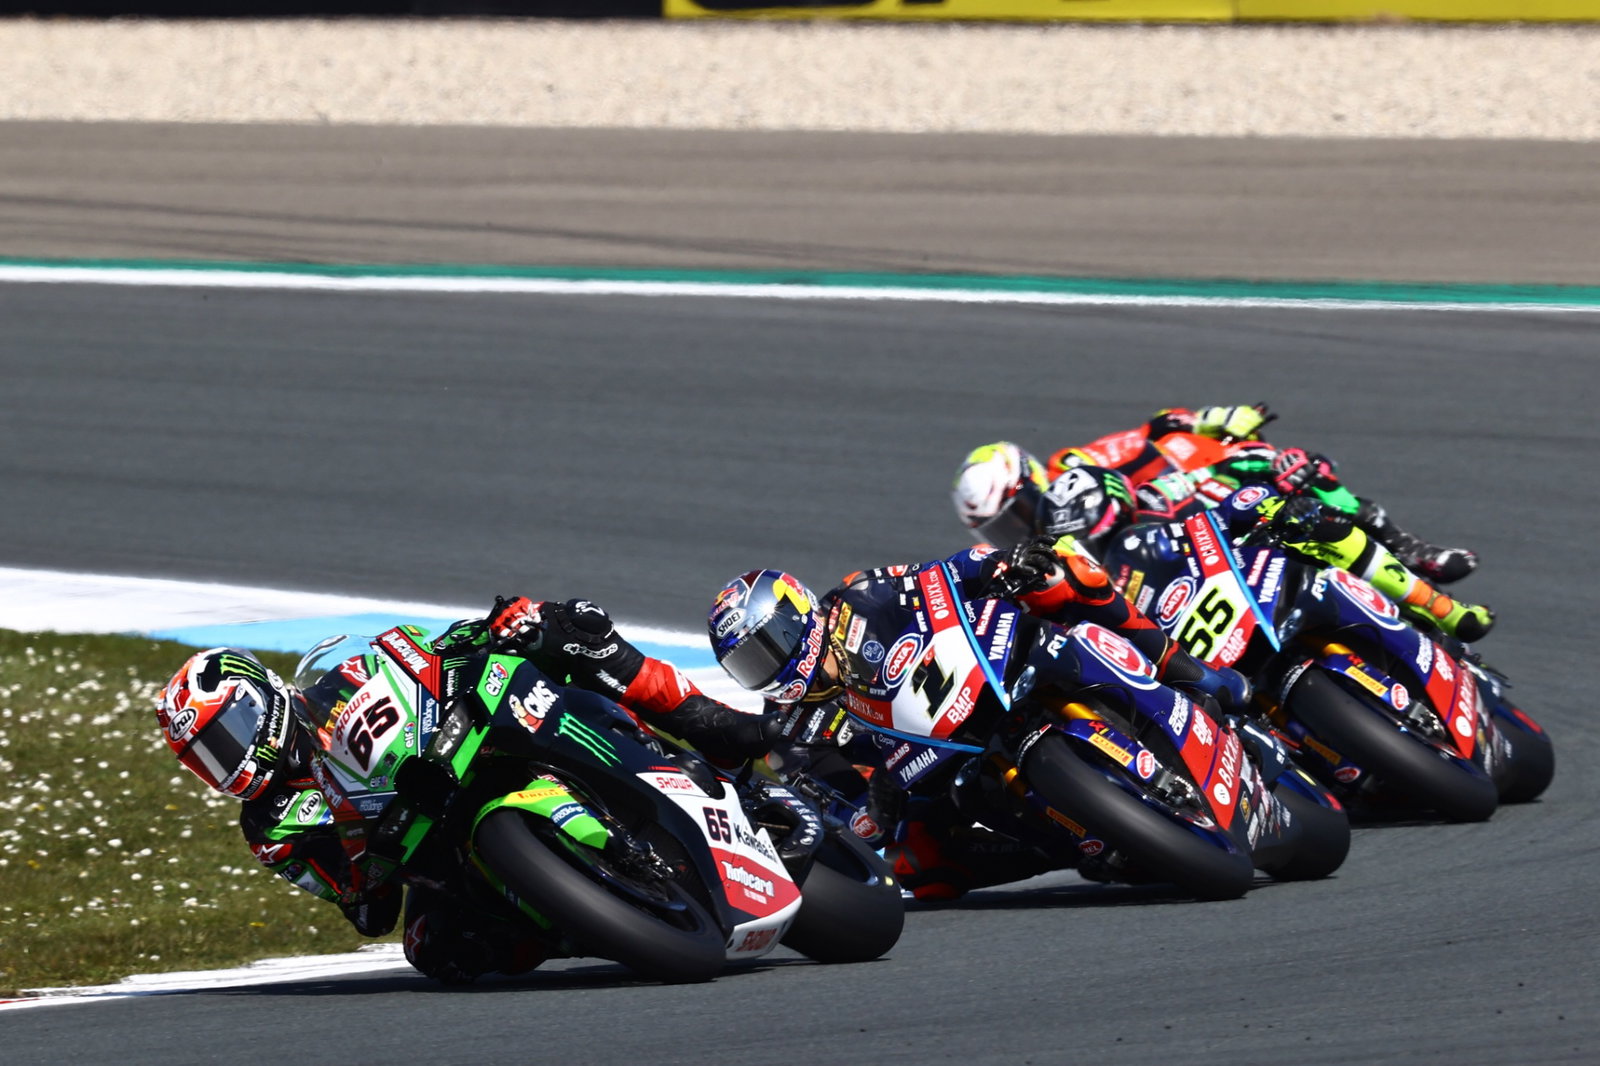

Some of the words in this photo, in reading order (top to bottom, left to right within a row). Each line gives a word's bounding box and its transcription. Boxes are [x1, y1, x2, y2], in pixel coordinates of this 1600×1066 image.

[1258, 557, 1286, 603] YAMAHA
[976, 599, 997, 635] McAMS
[1164, 587, 1186, 616] PATA
[718, 611, 741, 636] SHOEI
[988, 612, 1015, 660] YAMAHA
[1177, 587, 1235, 661] 55
[889, 643, 913, 676] PATA
[1219, 628, 1244, 663] BMP
[485, 671, 504, 697] elf
[523, 680, 559, 719] CMS
[911, 655, 957, 722] 1
[172, 711, 193, 735] Arai
[335, 691, 372, 746] SHOWA
[946, 686, 972, 724] BMP
[347, 696, 400, 772] 65
[900, 747, 938, 783] YAMAHA
[656, 776, 694, 791] SHOWA
[300, 796, 318, 816] Arai
[702, 806, 732, 845] 65
[721, 860, 775, 897] Motocard
